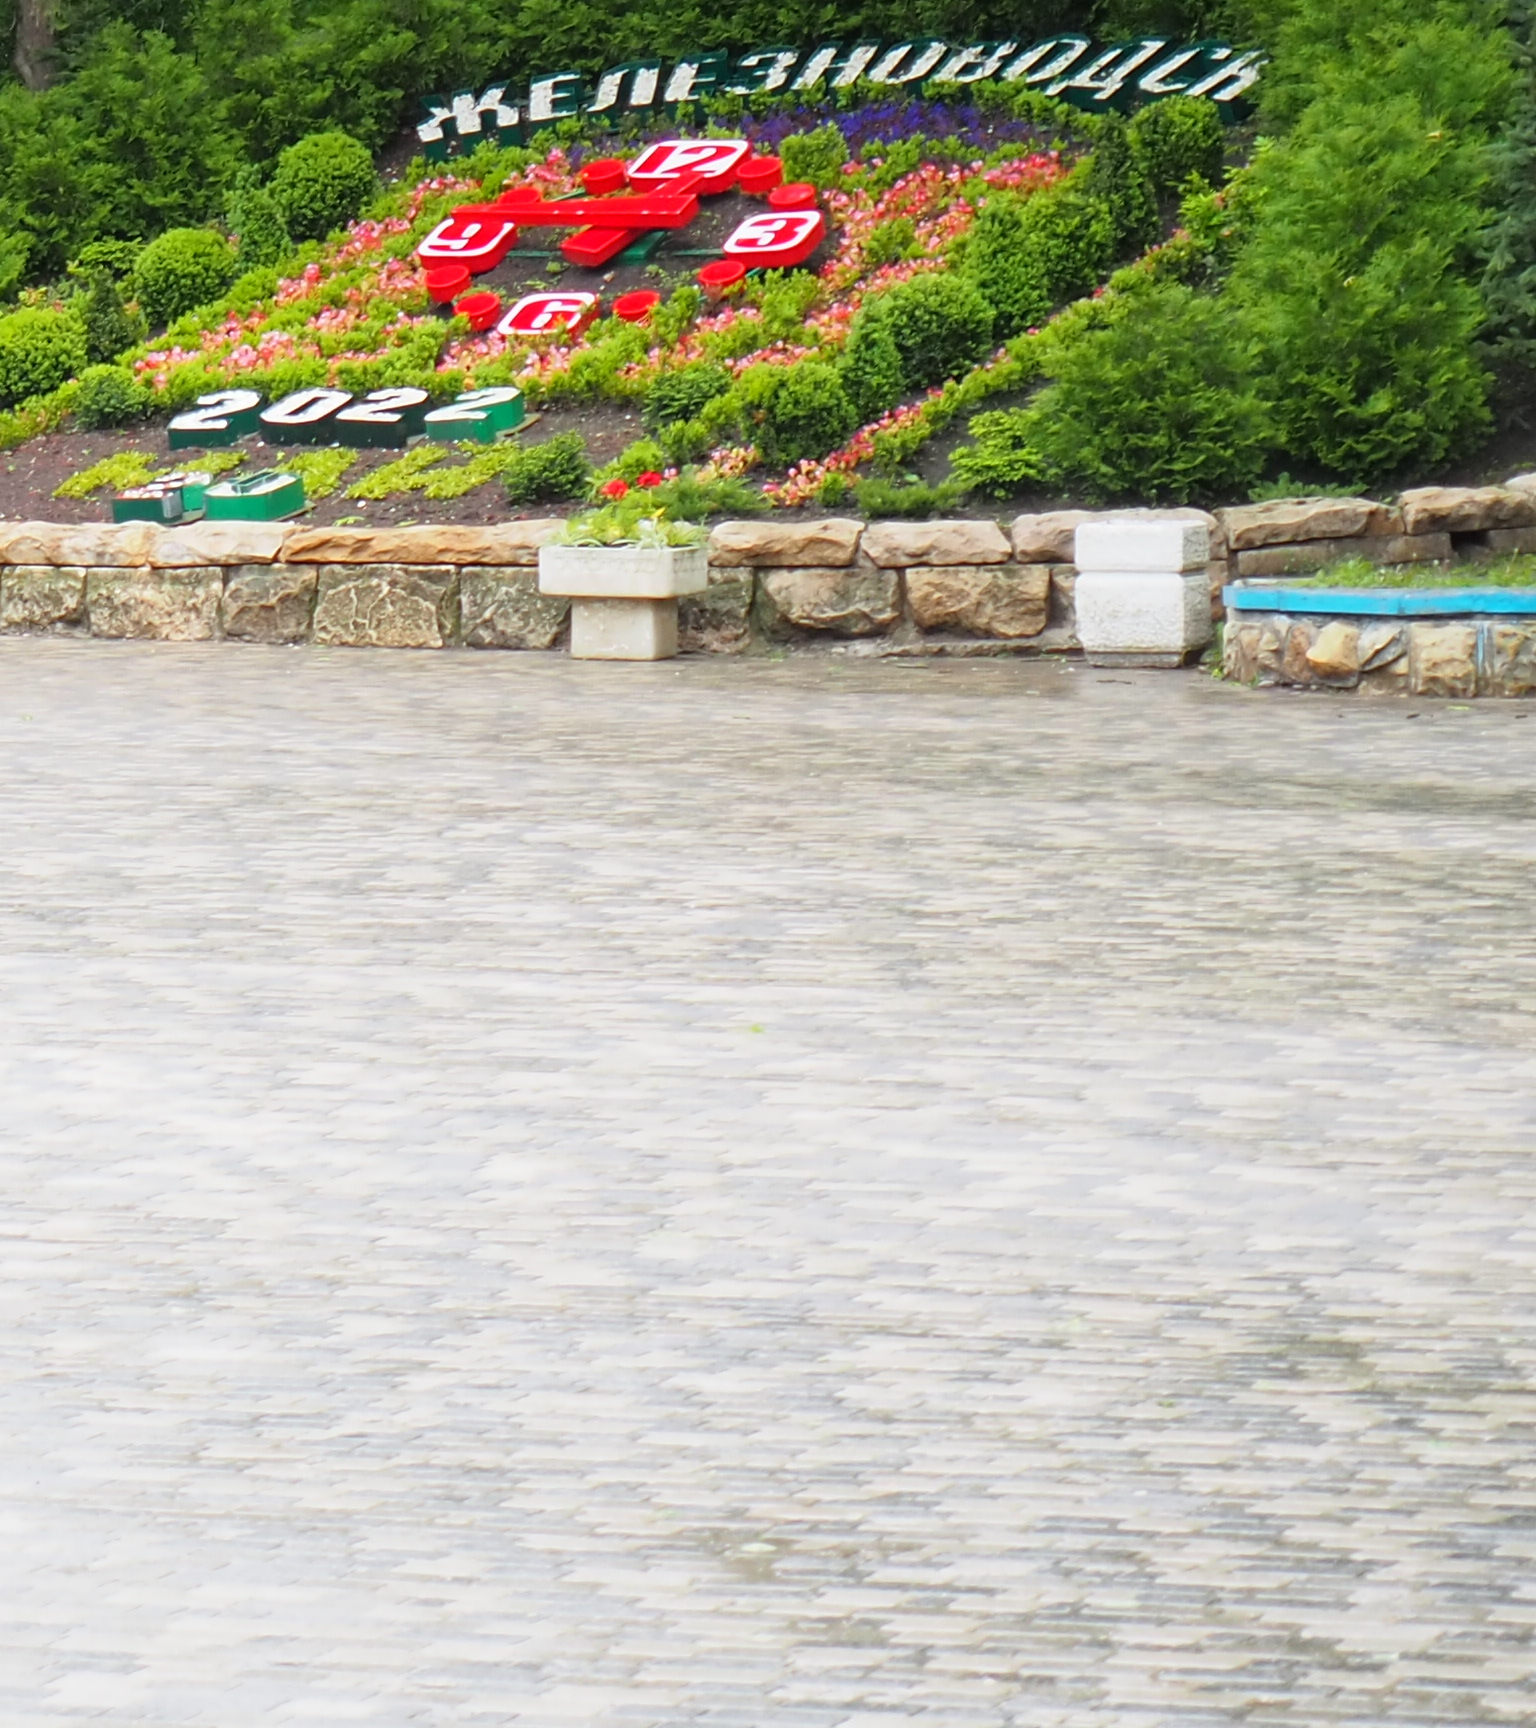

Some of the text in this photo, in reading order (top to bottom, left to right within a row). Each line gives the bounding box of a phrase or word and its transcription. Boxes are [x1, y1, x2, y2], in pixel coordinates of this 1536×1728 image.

[417, 38, 1270, 144] ЖЕЛЕЗНОВОДСК
[631, 145, 738, 175] 12
[734, 217, 810, 248] 3
[508, 299, 582, 332] 6
[168, 387, 525, 437] 2022
